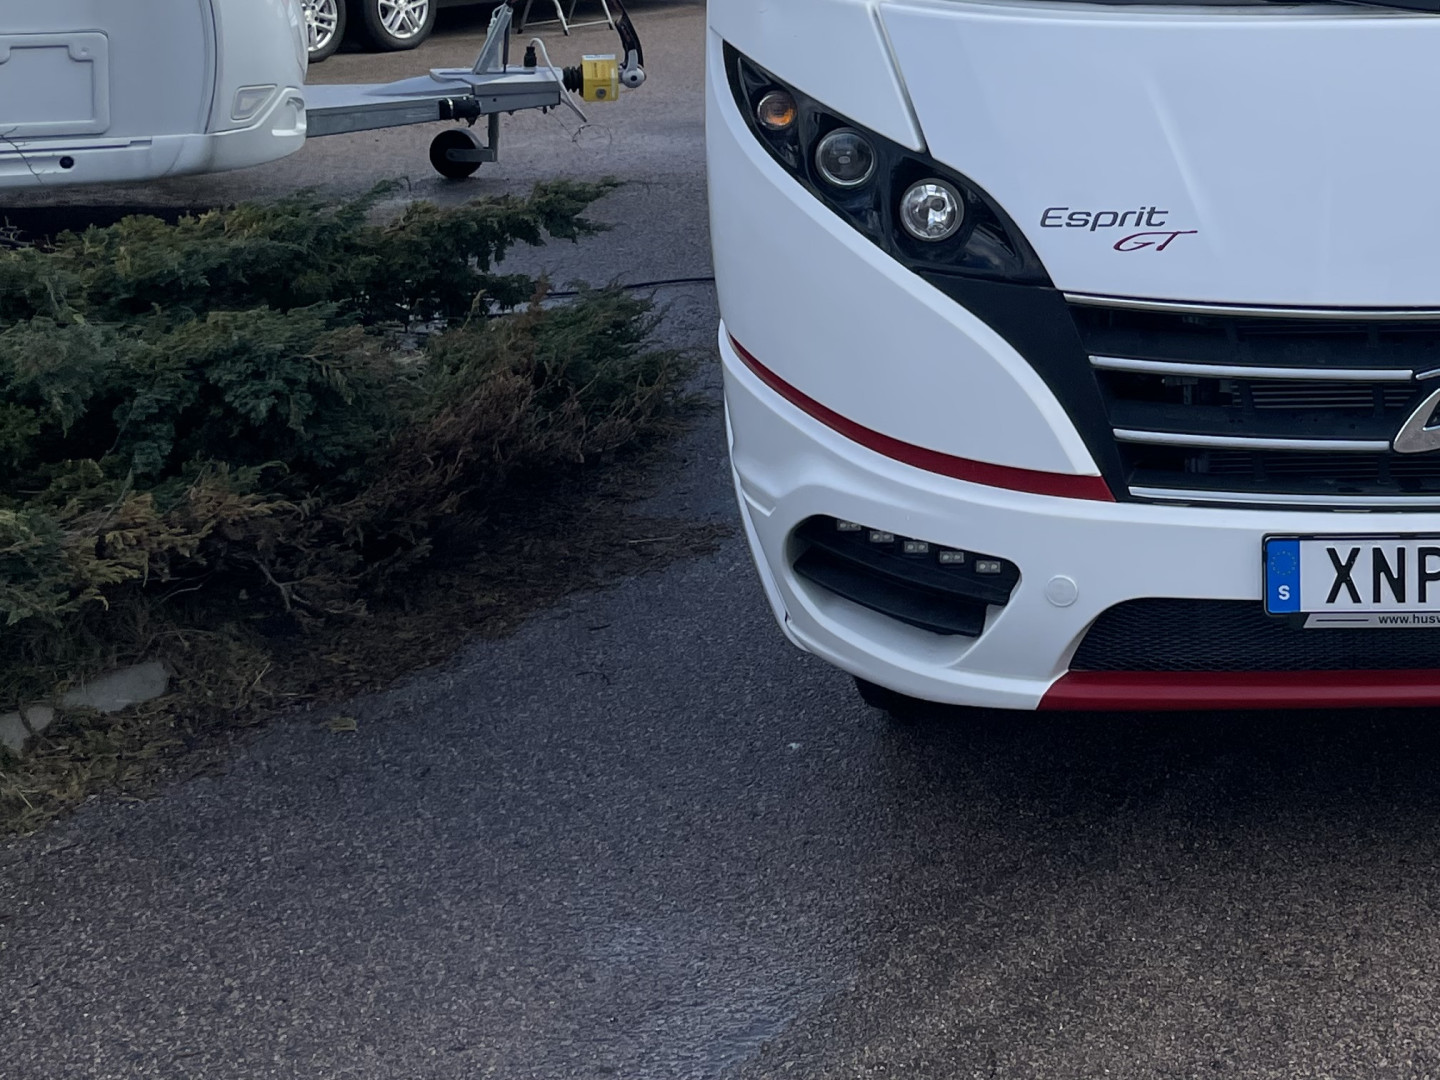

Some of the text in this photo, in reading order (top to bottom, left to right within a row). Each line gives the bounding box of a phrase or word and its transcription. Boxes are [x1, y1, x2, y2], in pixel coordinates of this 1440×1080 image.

[1040, 206, 1169, 232] Esprit
[1113, 230, 1198, 252] GT
[1277, 584, 1291, 601] S
